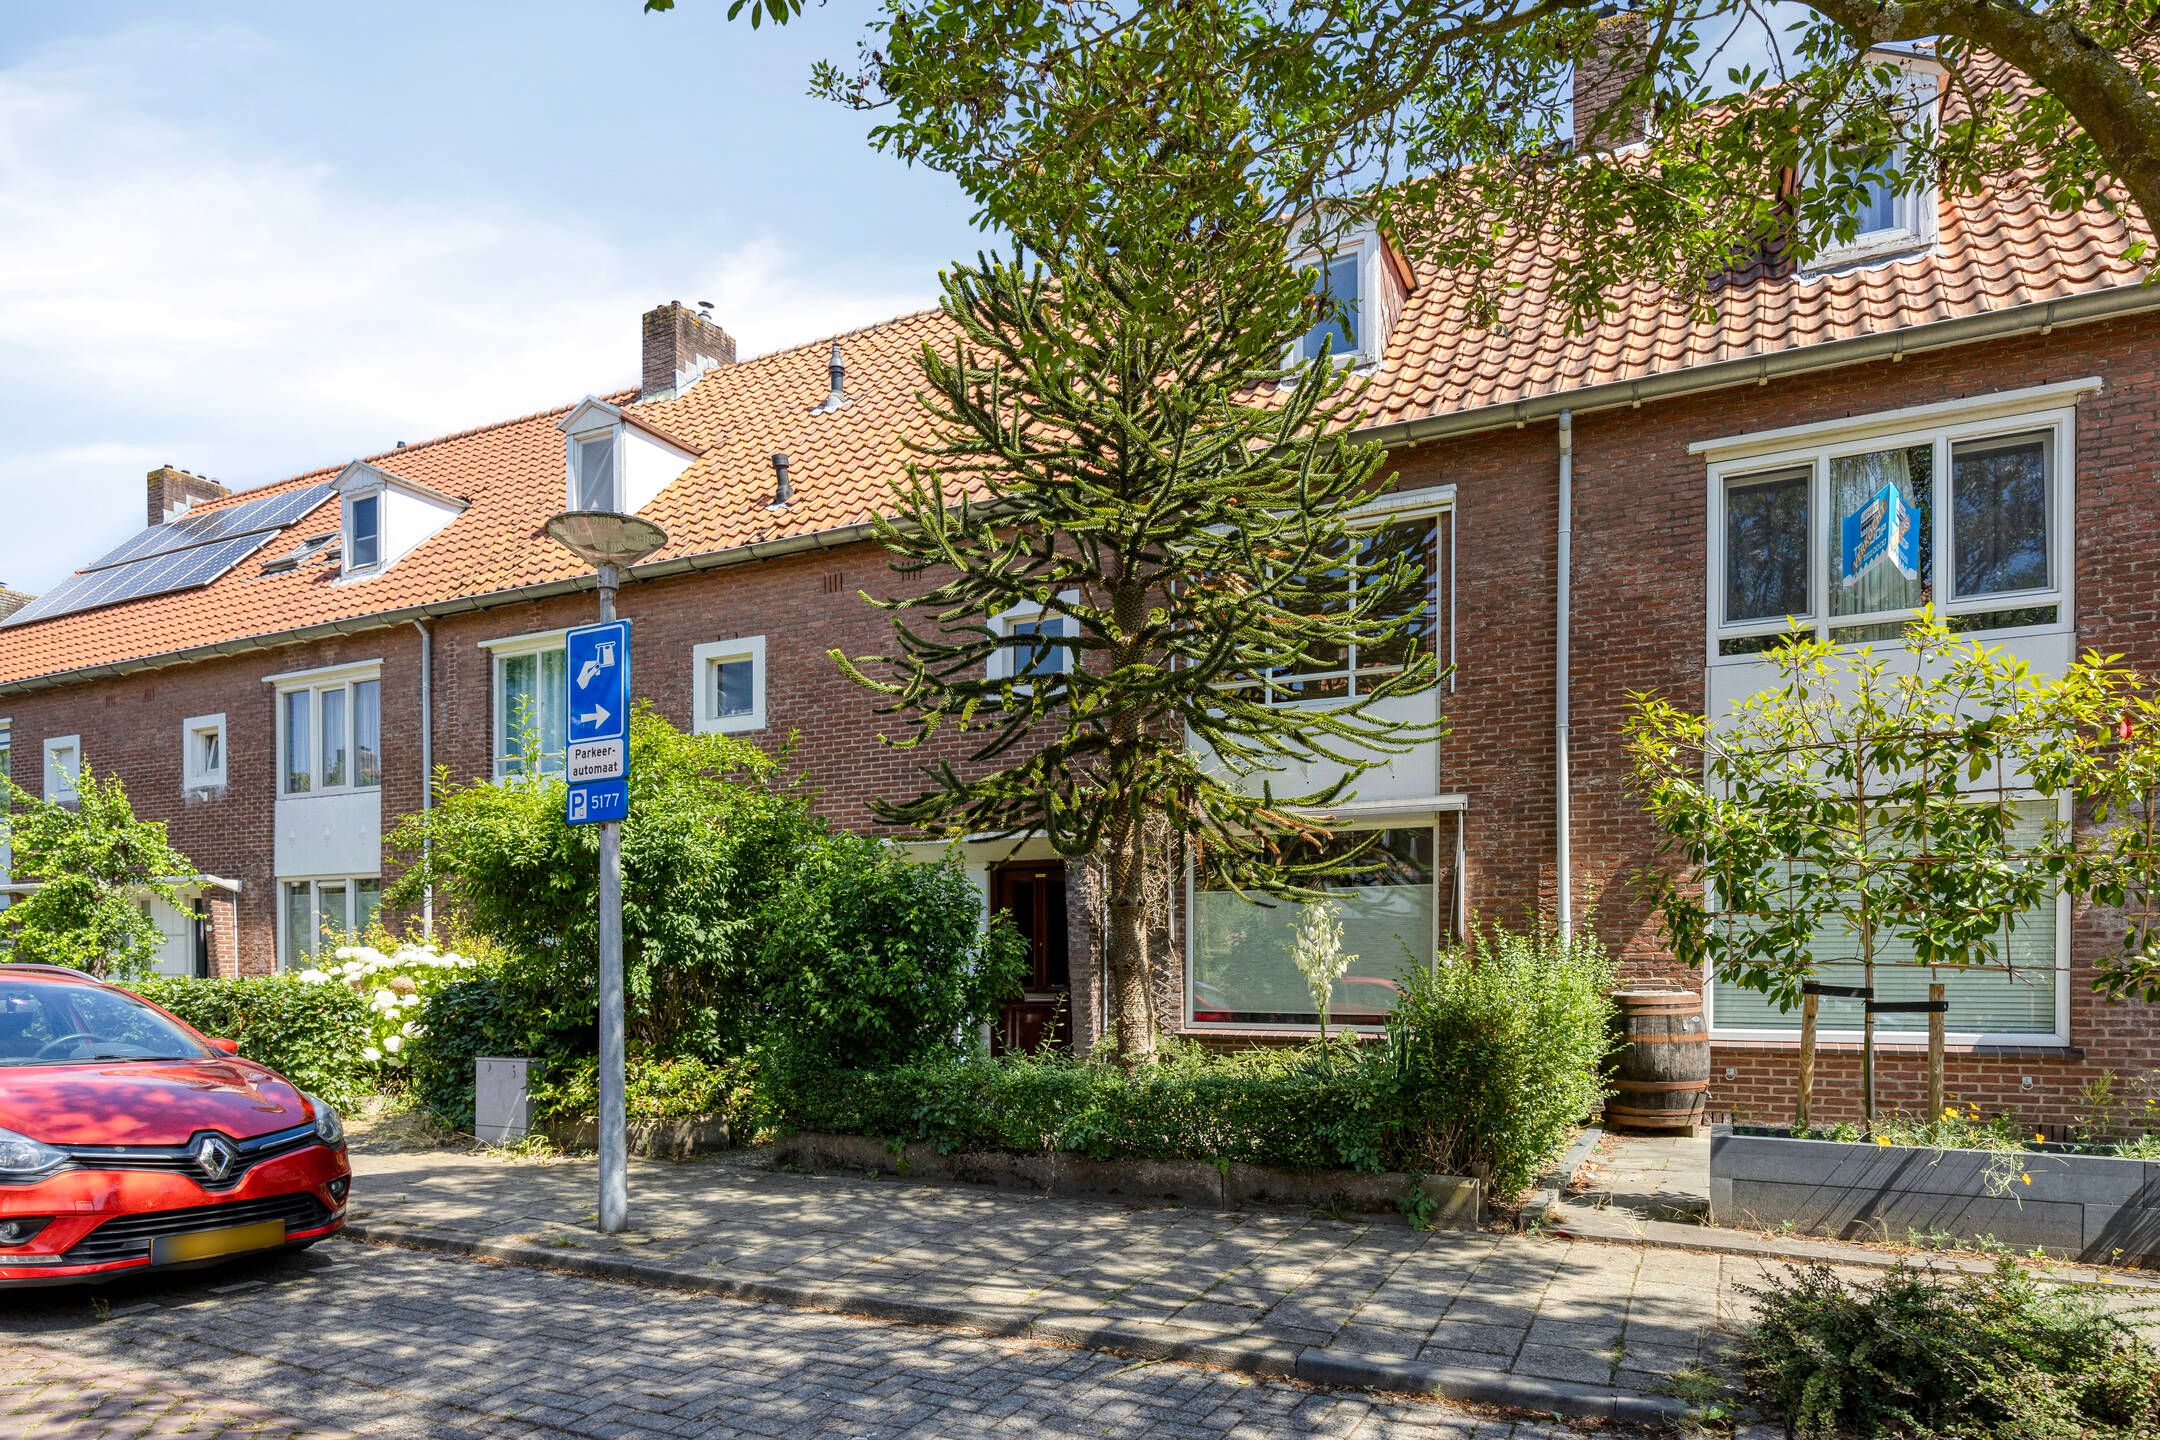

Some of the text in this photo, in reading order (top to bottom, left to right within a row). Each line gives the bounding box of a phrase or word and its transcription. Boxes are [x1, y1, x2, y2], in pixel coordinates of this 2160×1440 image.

[575, 747, 615, 759] Parkeer-
[573, 761, 618, 776] automaat
[571, 792, 619, 817] P 5177
